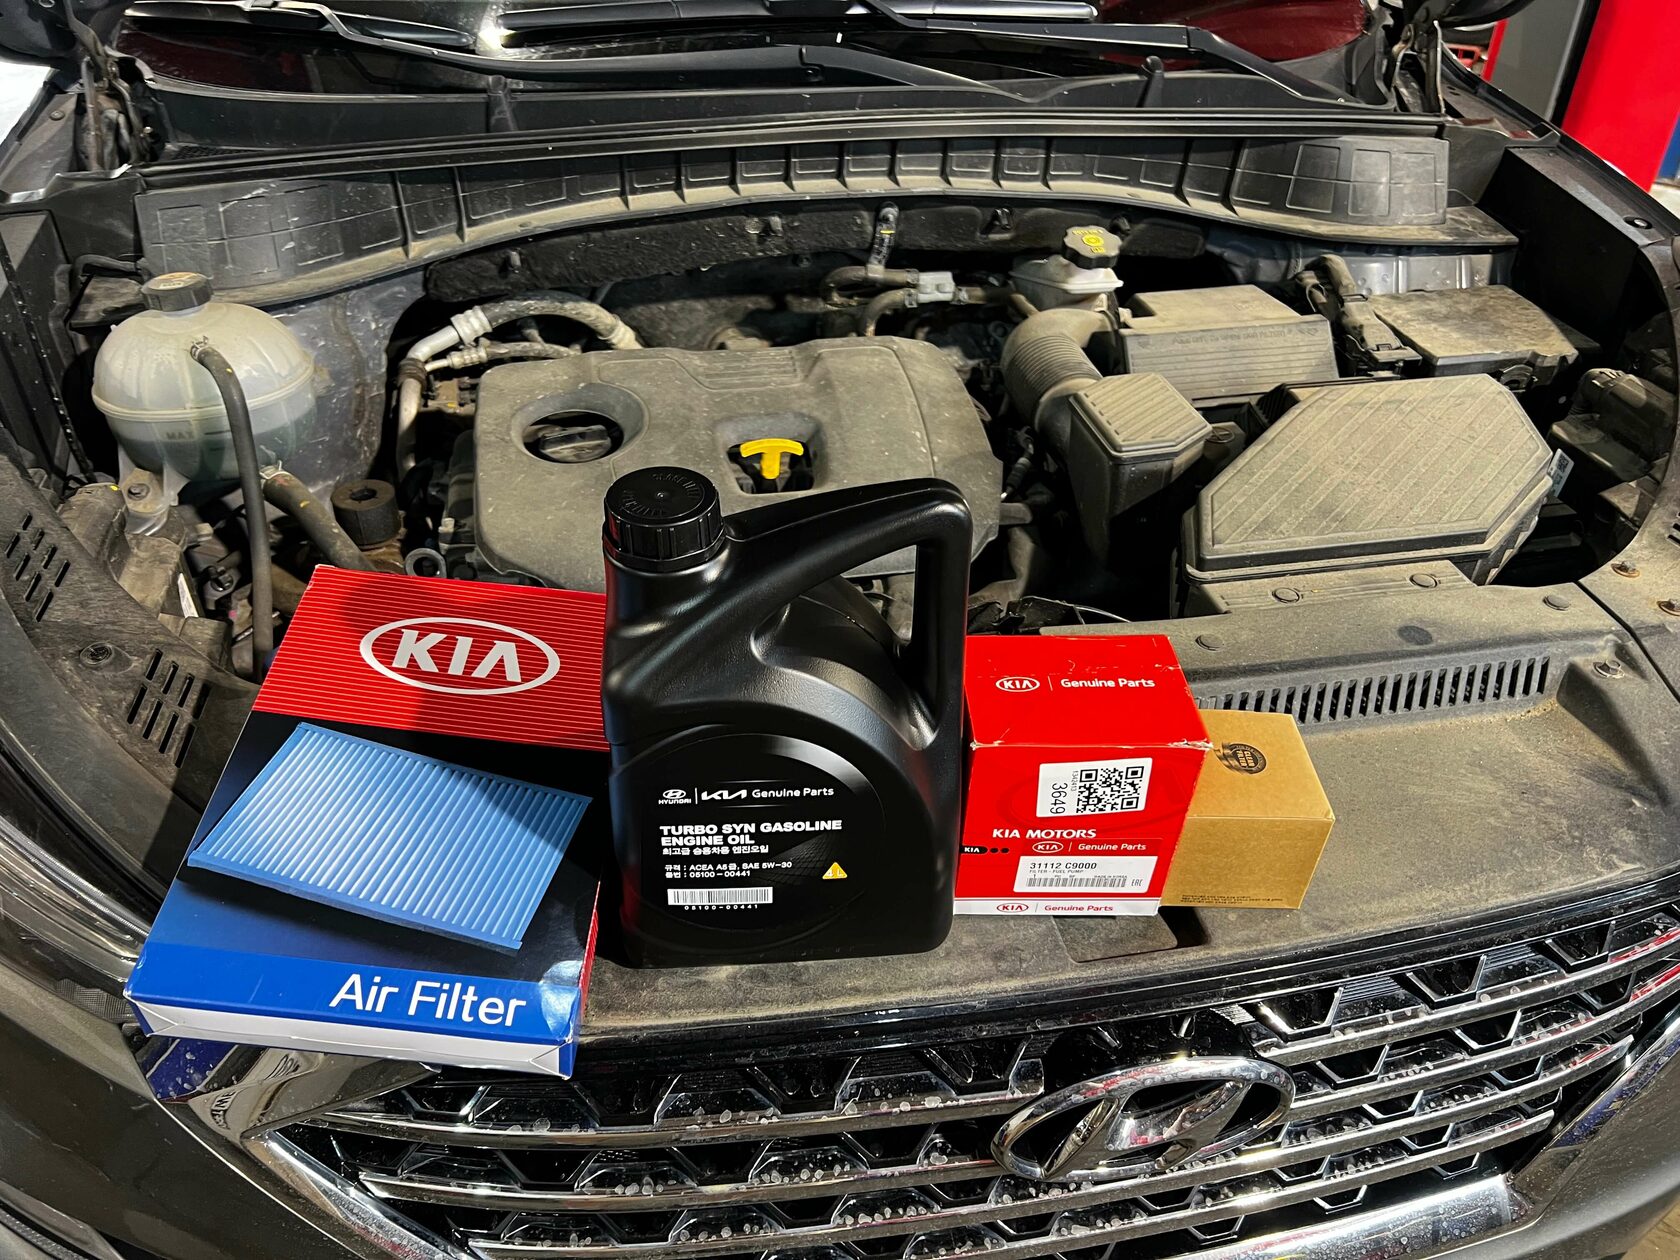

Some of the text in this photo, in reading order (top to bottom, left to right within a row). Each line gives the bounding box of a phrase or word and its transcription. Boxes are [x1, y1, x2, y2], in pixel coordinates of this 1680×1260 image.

[391, 628, 522, 683] KIA
[1060, 678, 1115, 688] Genuine
[1118, 677, 1156, 688] Parts
[751, 788, 801, 798] Genuine
[802, 787, 835, 797] Parts
[1049, 782, 1069, 815] 3649
[659, 819, 843, 836] TURBO SYN GASOLINE
[991, 828, 1097, 839] KIA MOTORS
[660, 833, 756, 847] ENGINE OIL
[731, 844, 769, 854] 엔진오일
[1078, 843, 1118, 851] Genuine
[1120, 843, 1147, 851] Parts
[689, 863, 714, 871] ACEA
[741, 862, 760, 870] SAE
[761, 861, 793, 869] 5W-30
[1064, 862, 1098, 870] C9000
[1044, 904, 1084, 912] Genuine
[1086, 904, 1114, 912] Parts
[329, 973, 527, 1027] Air Filter
